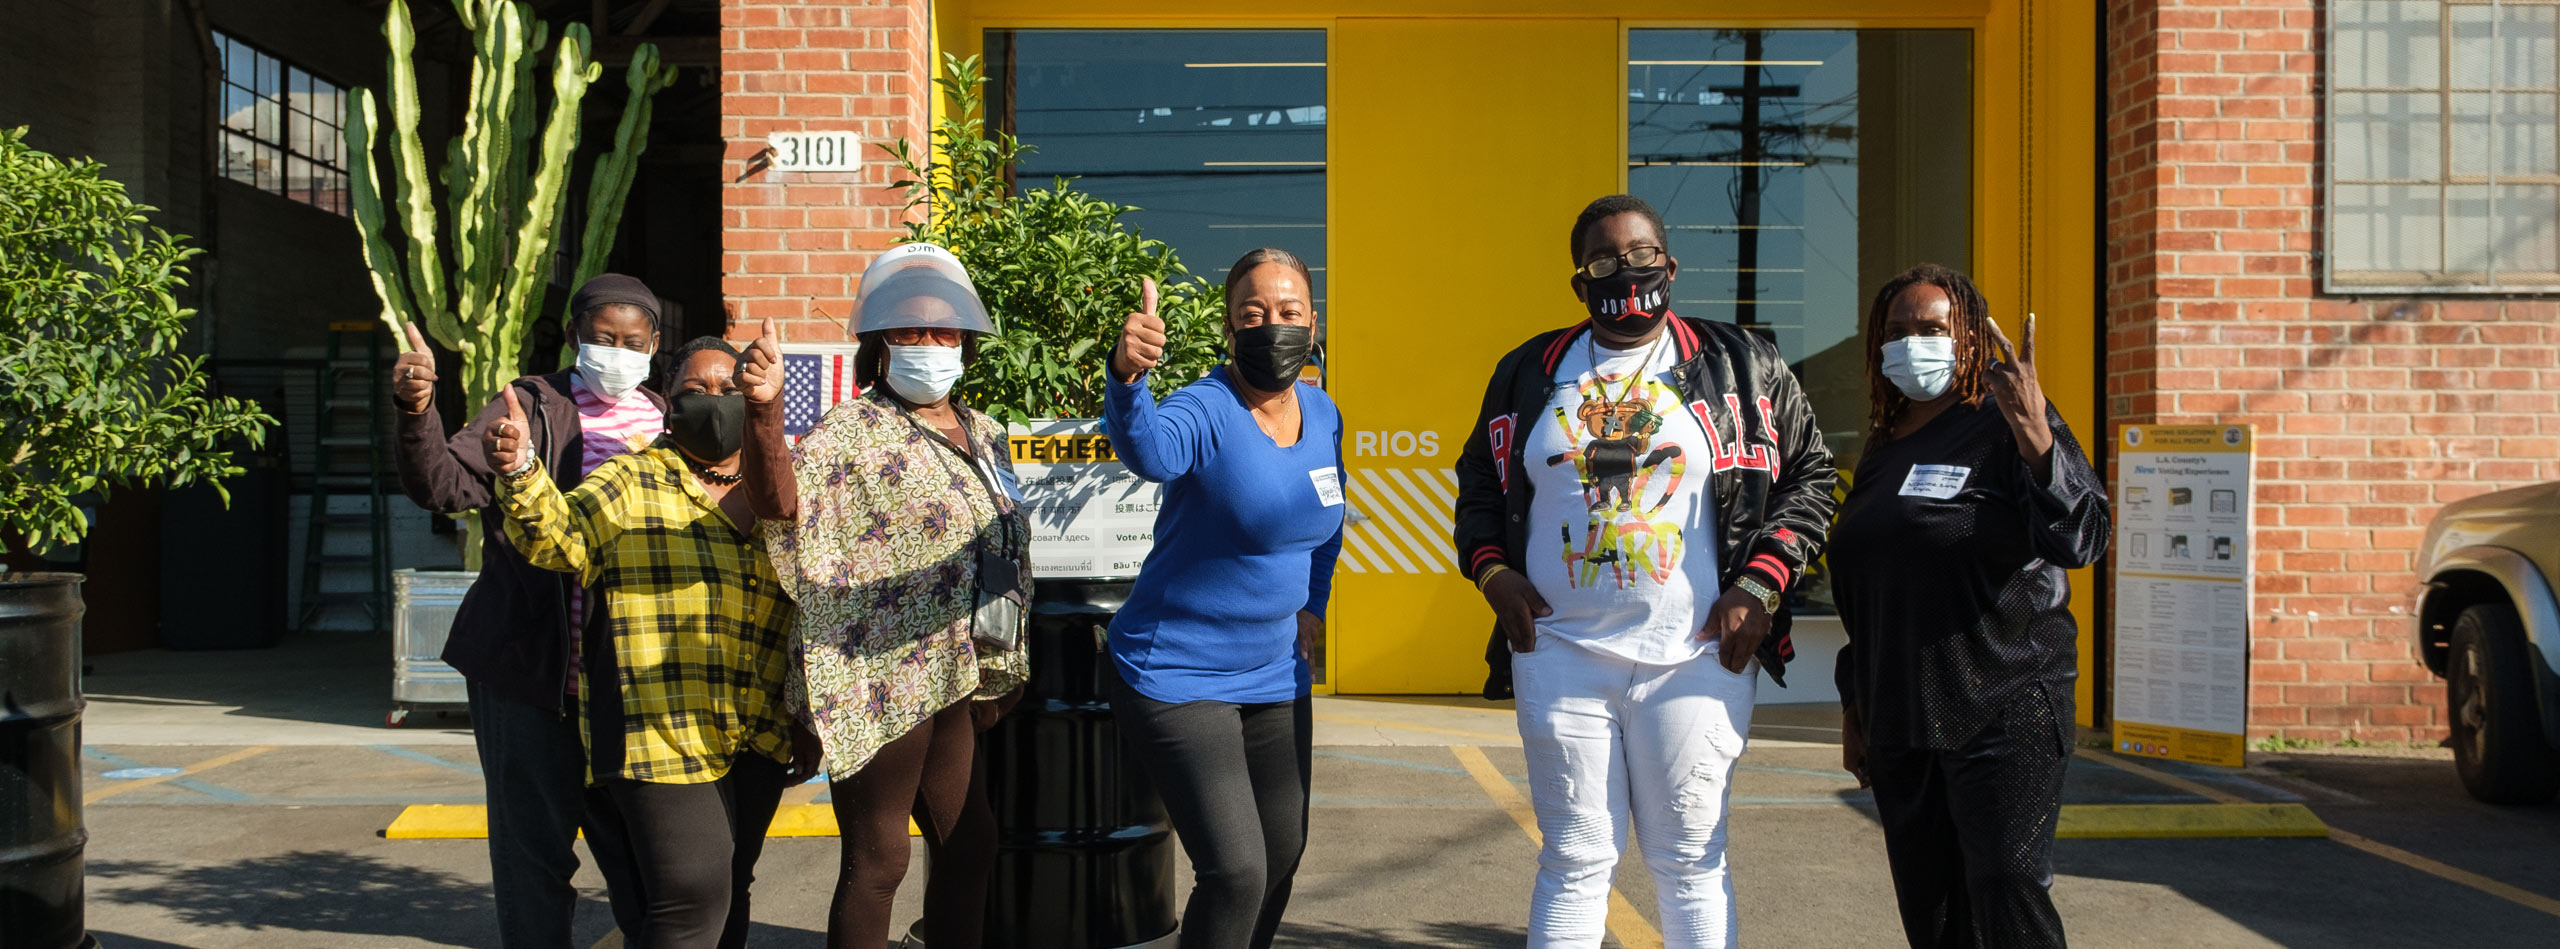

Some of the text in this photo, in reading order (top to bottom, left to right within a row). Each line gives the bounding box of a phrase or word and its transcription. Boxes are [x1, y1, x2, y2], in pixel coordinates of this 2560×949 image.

[781, 136, 846, 166] 3101
[1601, 290, 1662, 315] JORDAN
[1355, 430, 1440, 457] RIOS
[2134, 465, 2229, 476] New Voting Experience
[1065, 534, 1090, 542] здесь
[1116, 534, 1137, 542] Vote
[1561, 521, 1683, 590] HARD
